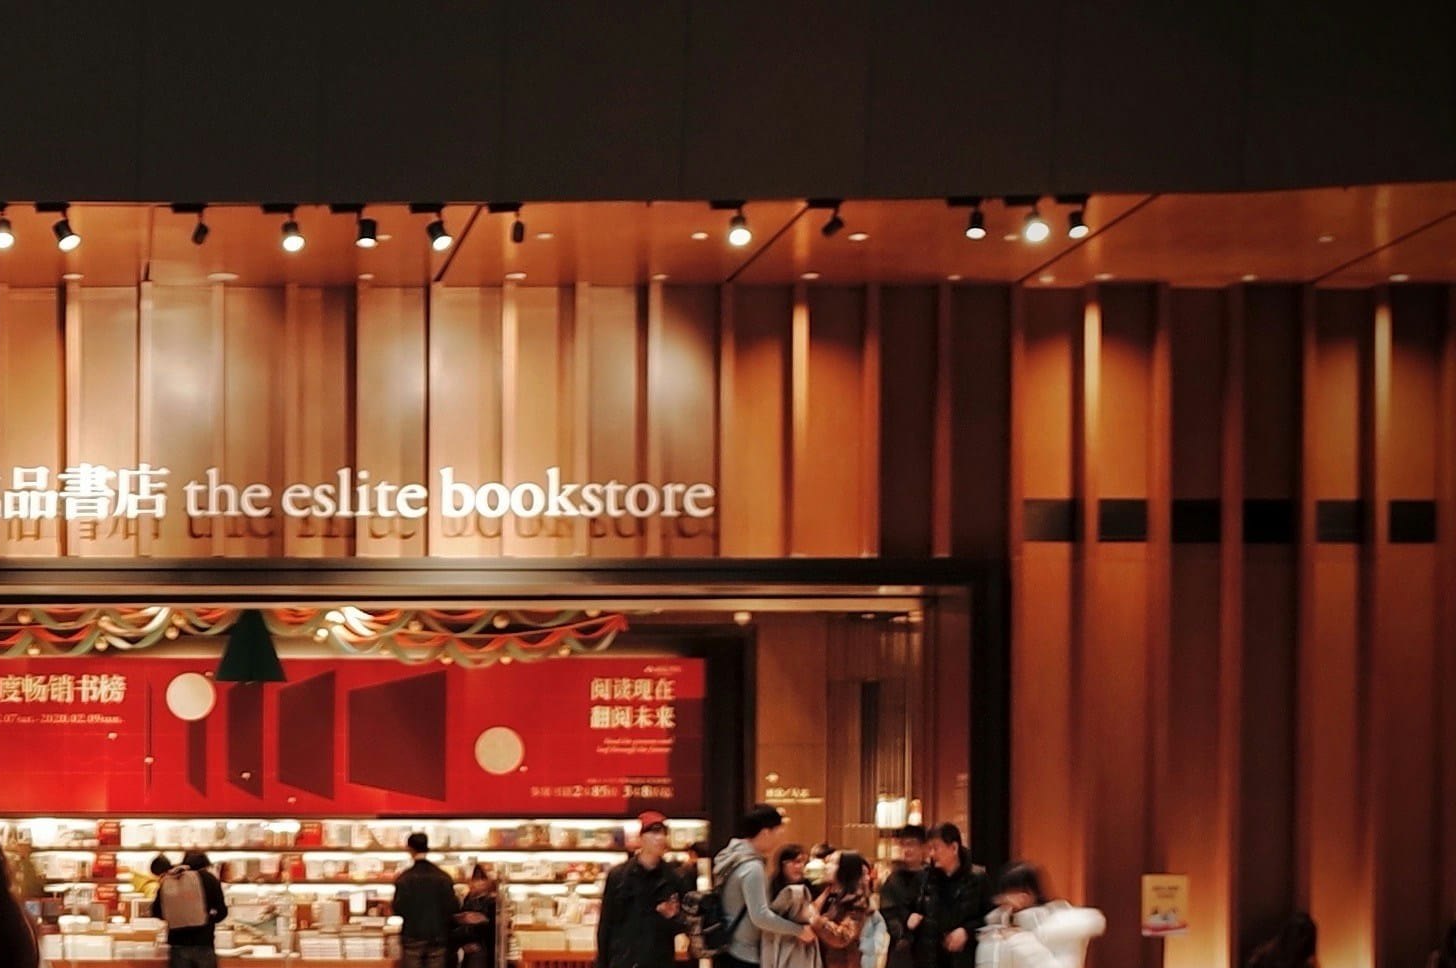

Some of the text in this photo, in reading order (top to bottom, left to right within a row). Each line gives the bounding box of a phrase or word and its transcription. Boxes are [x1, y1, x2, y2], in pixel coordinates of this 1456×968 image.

[183, 466, 716, 519] the eslite bookstore
